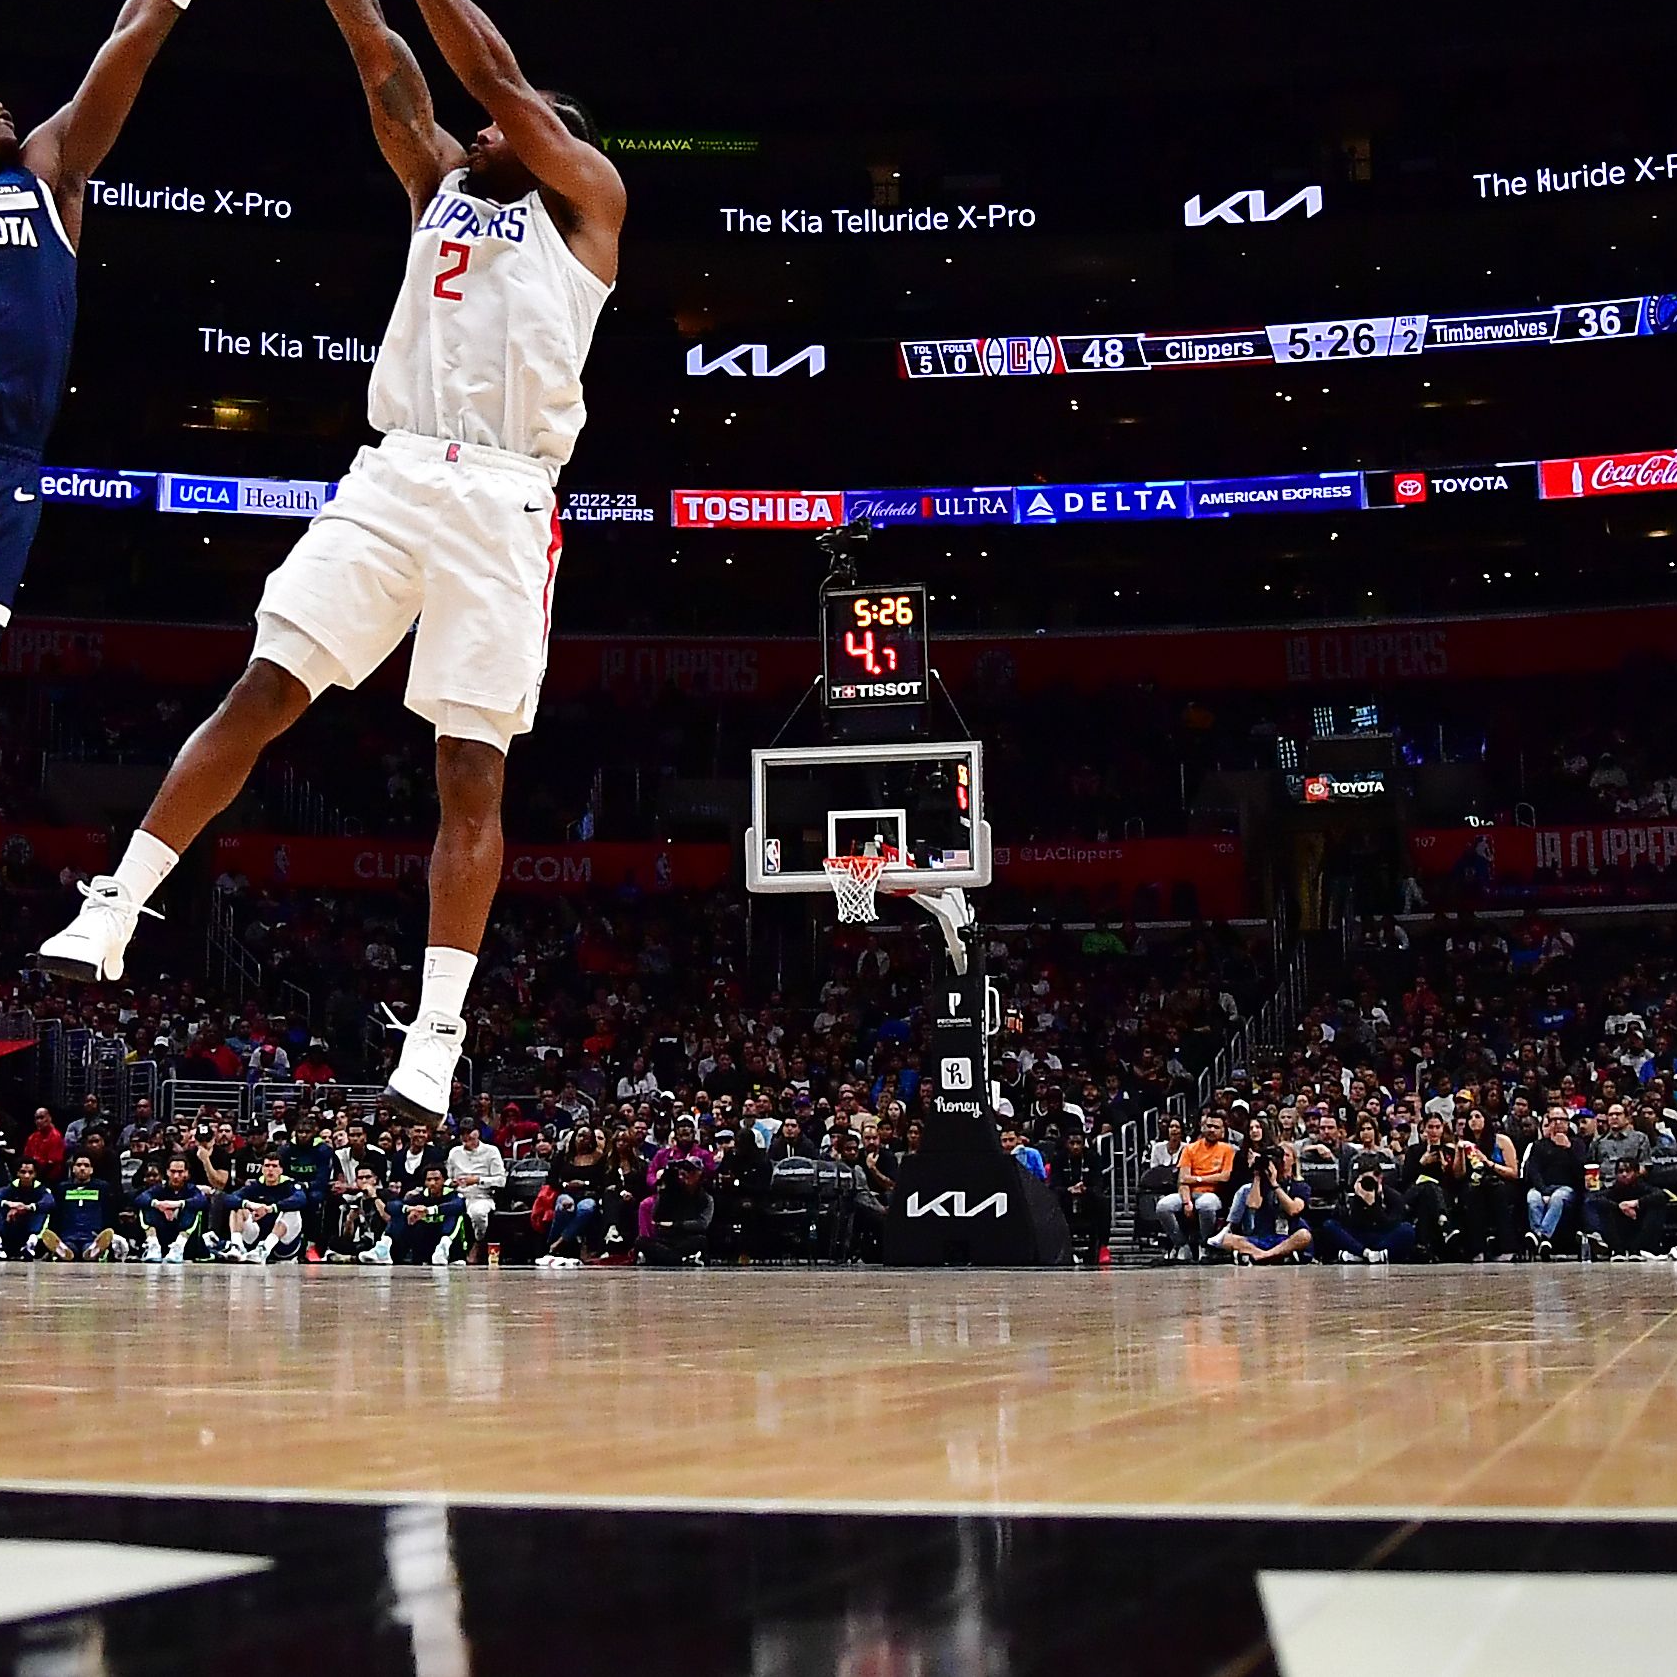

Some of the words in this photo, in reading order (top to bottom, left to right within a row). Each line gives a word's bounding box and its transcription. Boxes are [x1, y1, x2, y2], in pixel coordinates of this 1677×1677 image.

[1473, 173, 1527, 198] The
[87, 179, 206, 214] Telluride
[214, 190, 291, 218] X-Pro
[720, 209, 771, 232] The
[782, 209, 822, 233] Kia
[831, 207, 948, 233] Telluride
[958, 205, 1035, 229] X-Pro
[433, 240, 471, 301] 2
[199, 328, 250, 354] The
[261, 332, 302, 358] Kia
[313, 335, 379, 363] Tellu
[1082, 339, 1124, 367] 48
[1166, 340, 1254, 362] Clippers
[1288, 323, 1376, 360] 5:26
[1434, 318, 1548, 343] Timberwolves
[1577, 306, 1621, 336] 36
[40, 473, 132, 500] ectrum
[1199, 489, 1278, 506] AMERICAN
[1281, 485, 1352, 500] EXPRESS
[1431, 474, 1509, 493] TOYOTA
[179, 485, 230, 504] UCLA
[244, 488, 319, 510] Health
[569, 493, 637, 507] 2022-23
[683, 495, 834, 522] TOSHIBA
[934, 495, 1009, 516] ULTRA
[1064, 489, 1177, 512] DELTA
[576, 508, 654, 521] CLIPPERS
[855, 597, 913, 627] 5:26
[856, 682, 921, 697] TISSOT
[1332, 781, 1384, 793] TOYOTA
[934, 1095, 982, 1119] honey
